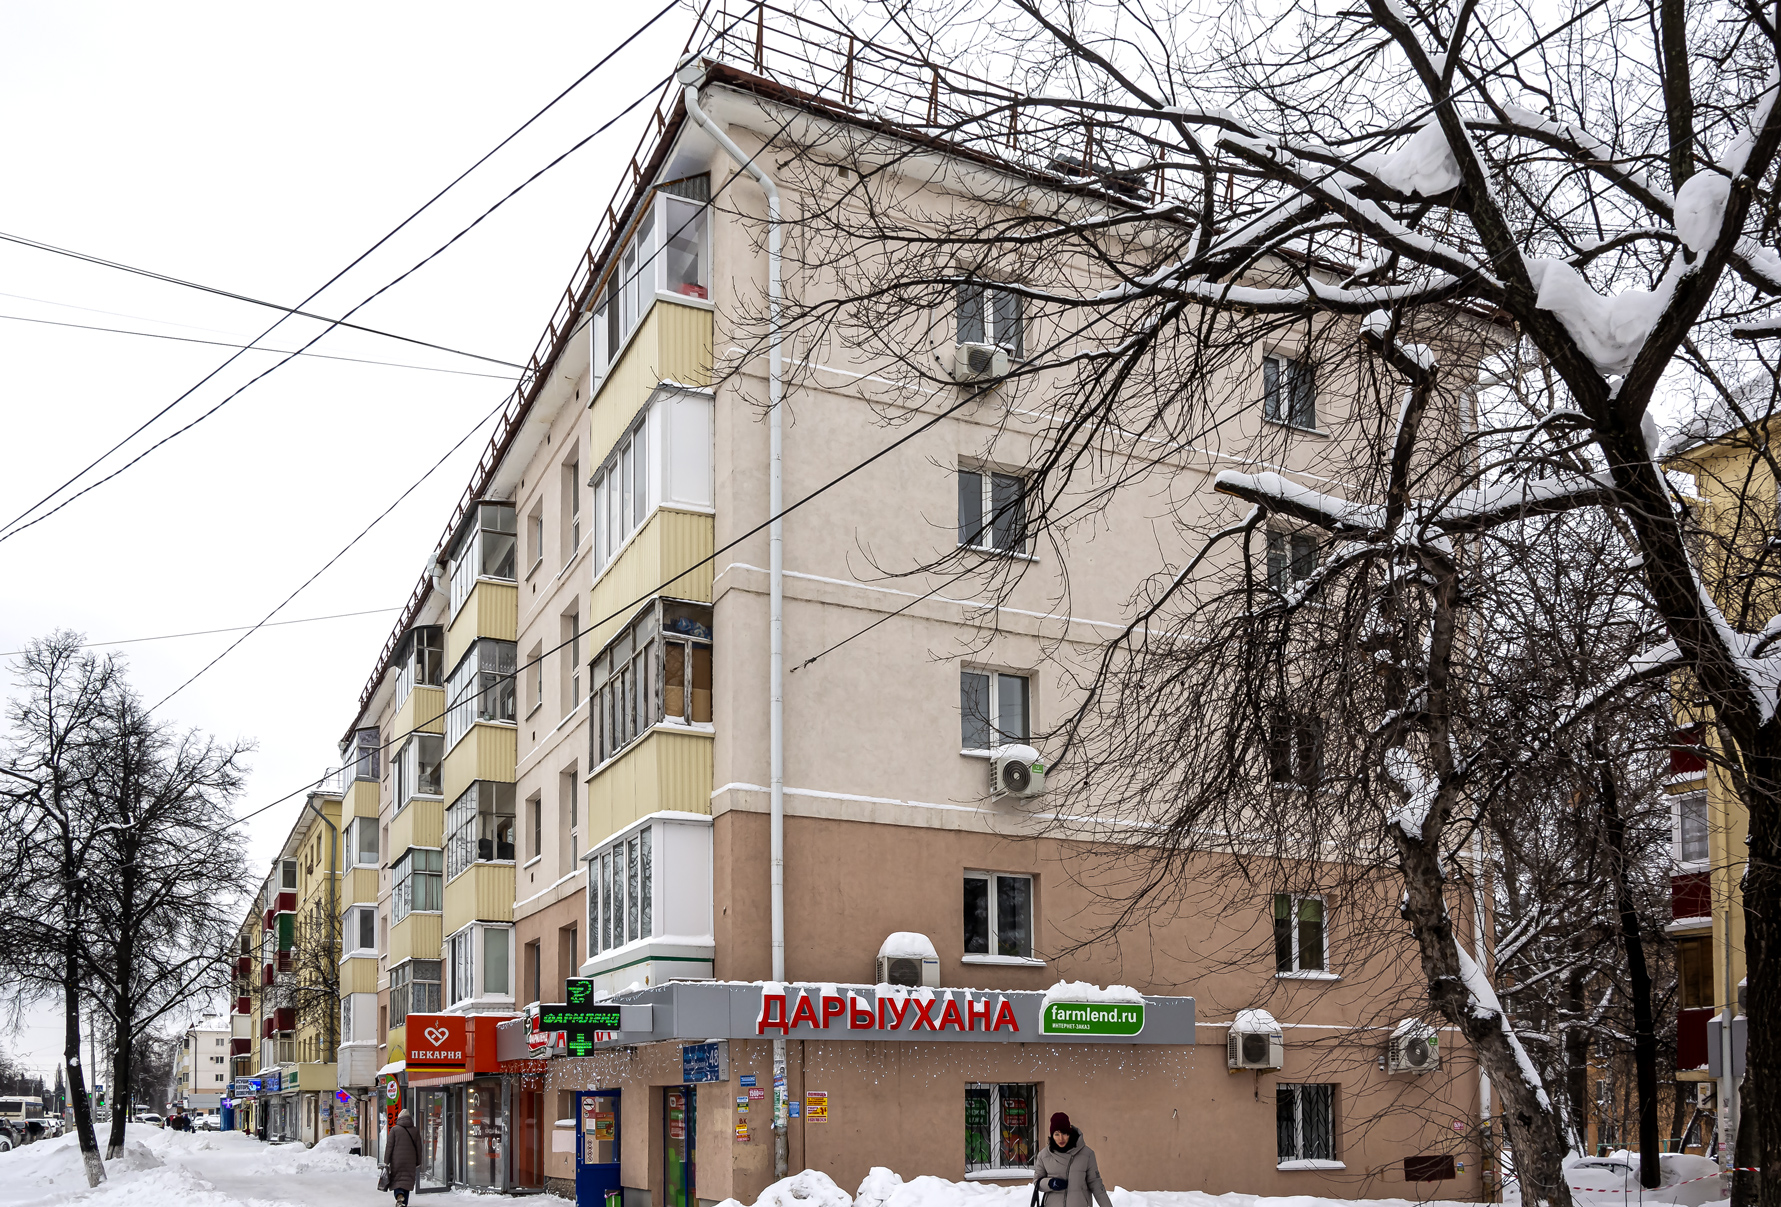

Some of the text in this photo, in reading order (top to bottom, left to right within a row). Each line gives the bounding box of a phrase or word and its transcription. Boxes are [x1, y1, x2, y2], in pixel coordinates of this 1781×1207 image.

[757, 994, 1019, 1035] ДАРЫУХАНА
[1051, 1005, 1137, 1023] farmlend.ru
[411, 1050, 462, 1059] ПЕКАРНЯ
[709, 1049, 719, 1066] 48
